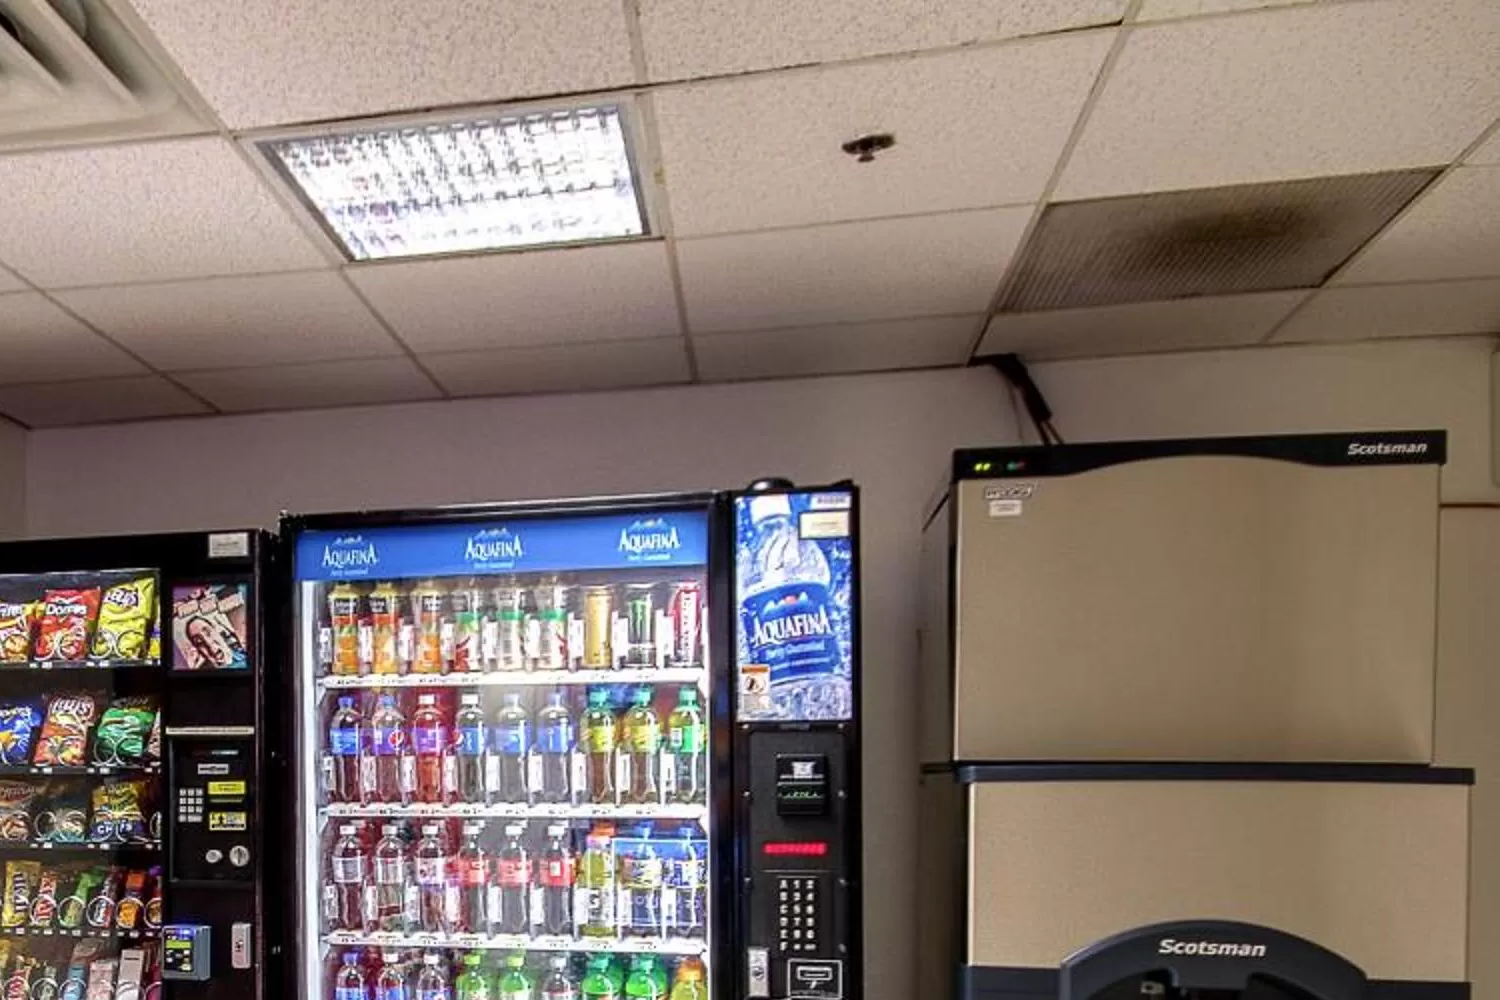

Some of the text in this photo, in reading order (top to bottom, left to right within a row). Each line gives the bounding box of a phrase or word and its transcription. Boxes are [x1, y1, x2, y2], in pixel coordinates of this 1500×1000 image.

[1347, 442, 1428, 456] Scotsman
[465, 534, 524, 561] AQUAFINA
[617, 526, 680, 553] AQUAFINA
[322, 542, 379, 568] AQUAFINA
[753, 603, 834, 649] AQUAFINA
[1158, 938, 1267, 957] Scotsman
